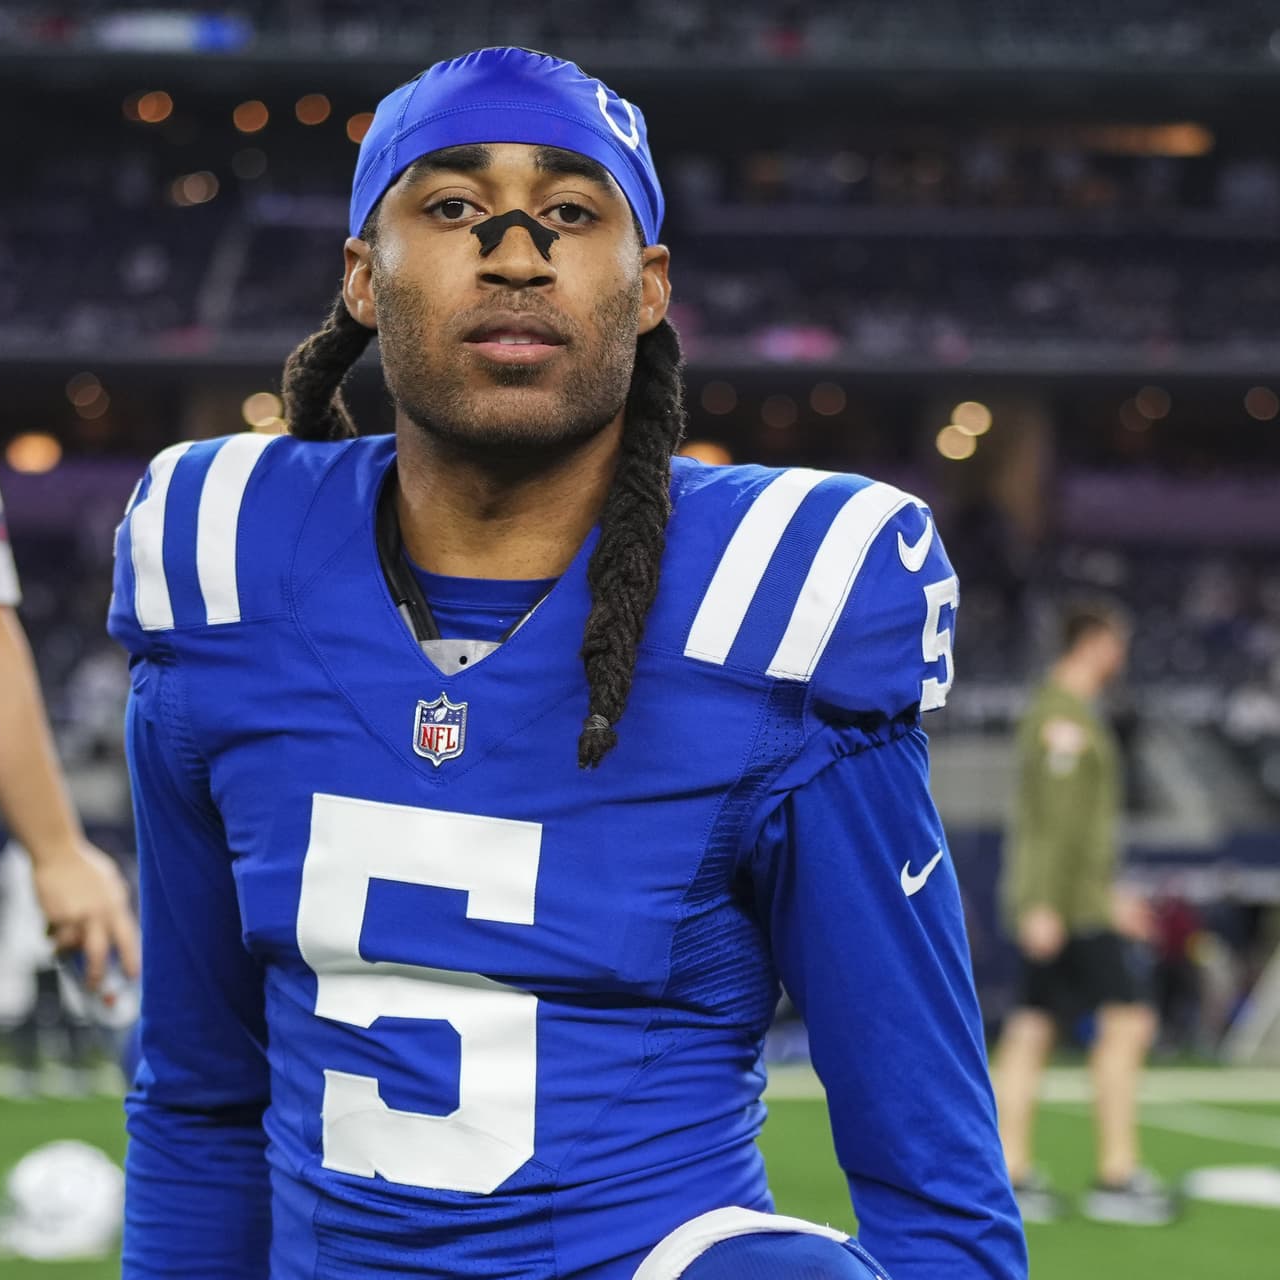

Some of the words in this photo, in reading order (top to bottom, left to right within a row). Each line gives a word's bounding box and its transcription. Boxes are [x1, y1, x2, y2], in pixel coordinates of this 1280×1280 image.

[920, 575, 960, 713] 5
[421, 726, 456, 752] NFL
[296, 792, 543, 1195] 5
